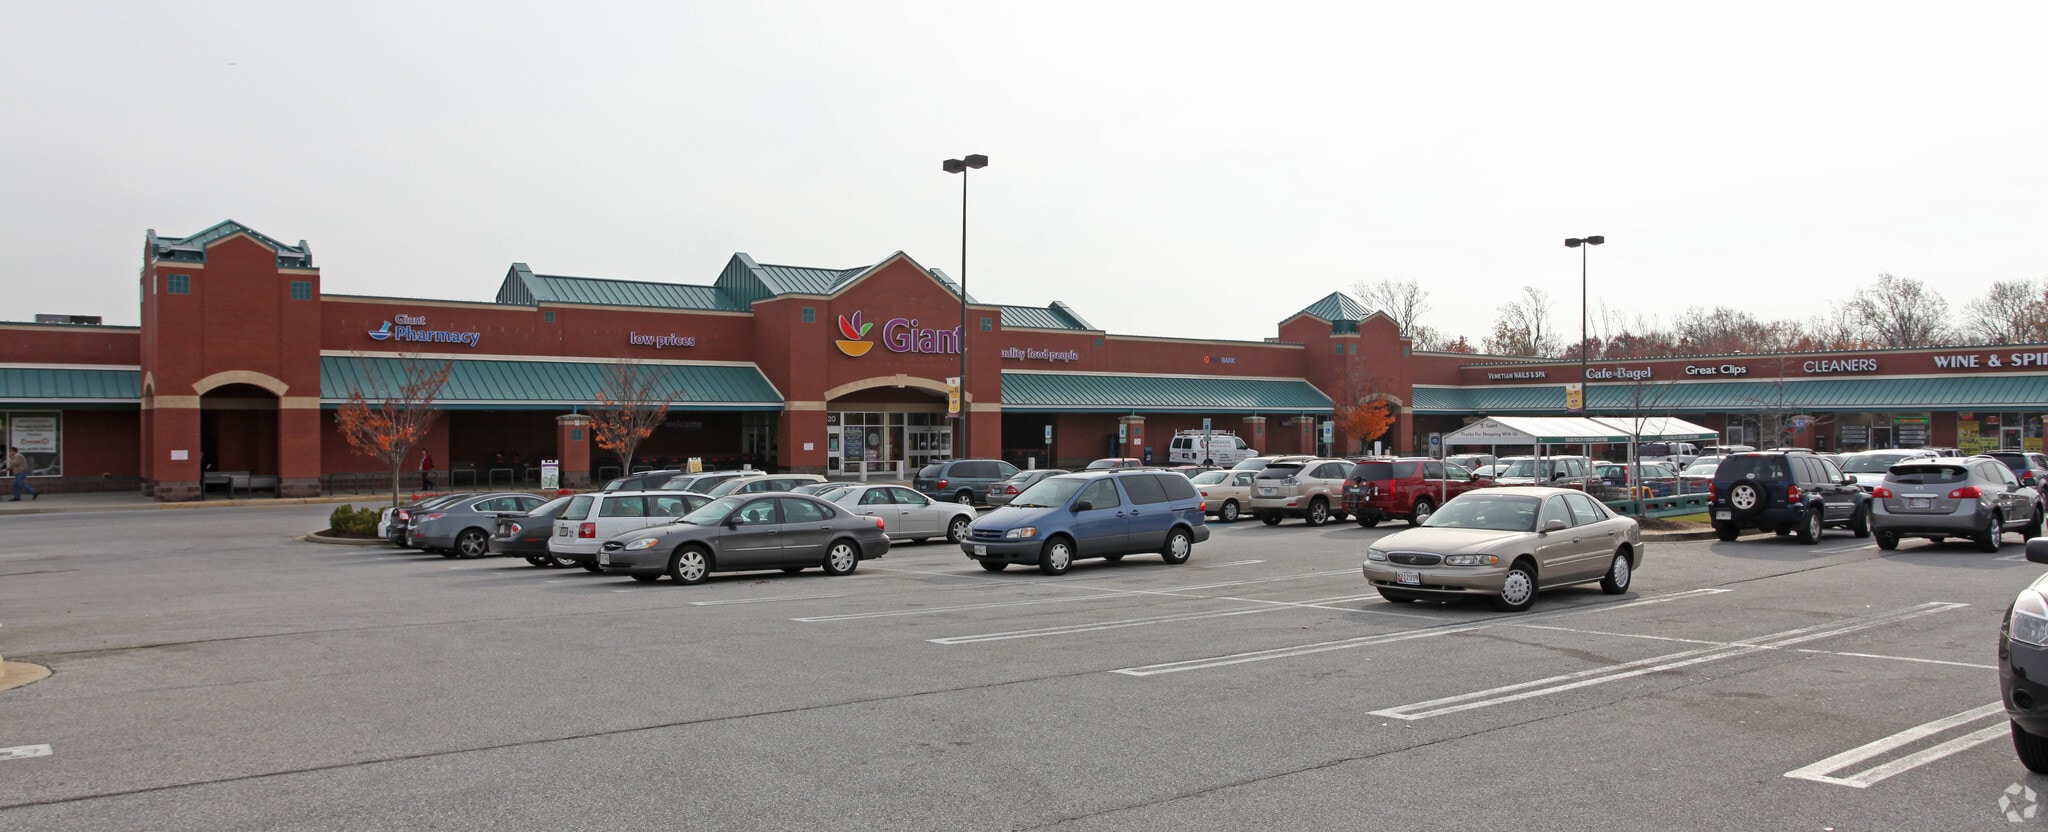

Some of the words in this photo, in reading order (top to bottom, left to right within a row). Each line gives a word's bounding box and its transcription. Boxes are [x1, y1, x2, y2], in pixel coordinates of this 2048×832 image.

[394, 313, 426, 325] Giant
[394, 325, 480, 347] Pharmacy
[630, 331, 655, 345] low
[656, 333, 696, 349] prices
[883, 318, 968, 354] Giant
[1000, 348, 1026, 362] uality
[1027, 348, 1049, 360] food
[1049, 350, 1080, 363] people
[1933, 354, 1980, 368] WINE
[1987, 354, 2002, 367] &
[1685, 365, 1717, 375] Great
[1720, 364, 1747, 375] Clips
[1803, 358, 1877, 373] CLEANERS
[1514, 371, 1530, 379] NAILS
[1585, 367, 1613, 380] Cafe
[1617, 366, 1652, 380] Bagel
